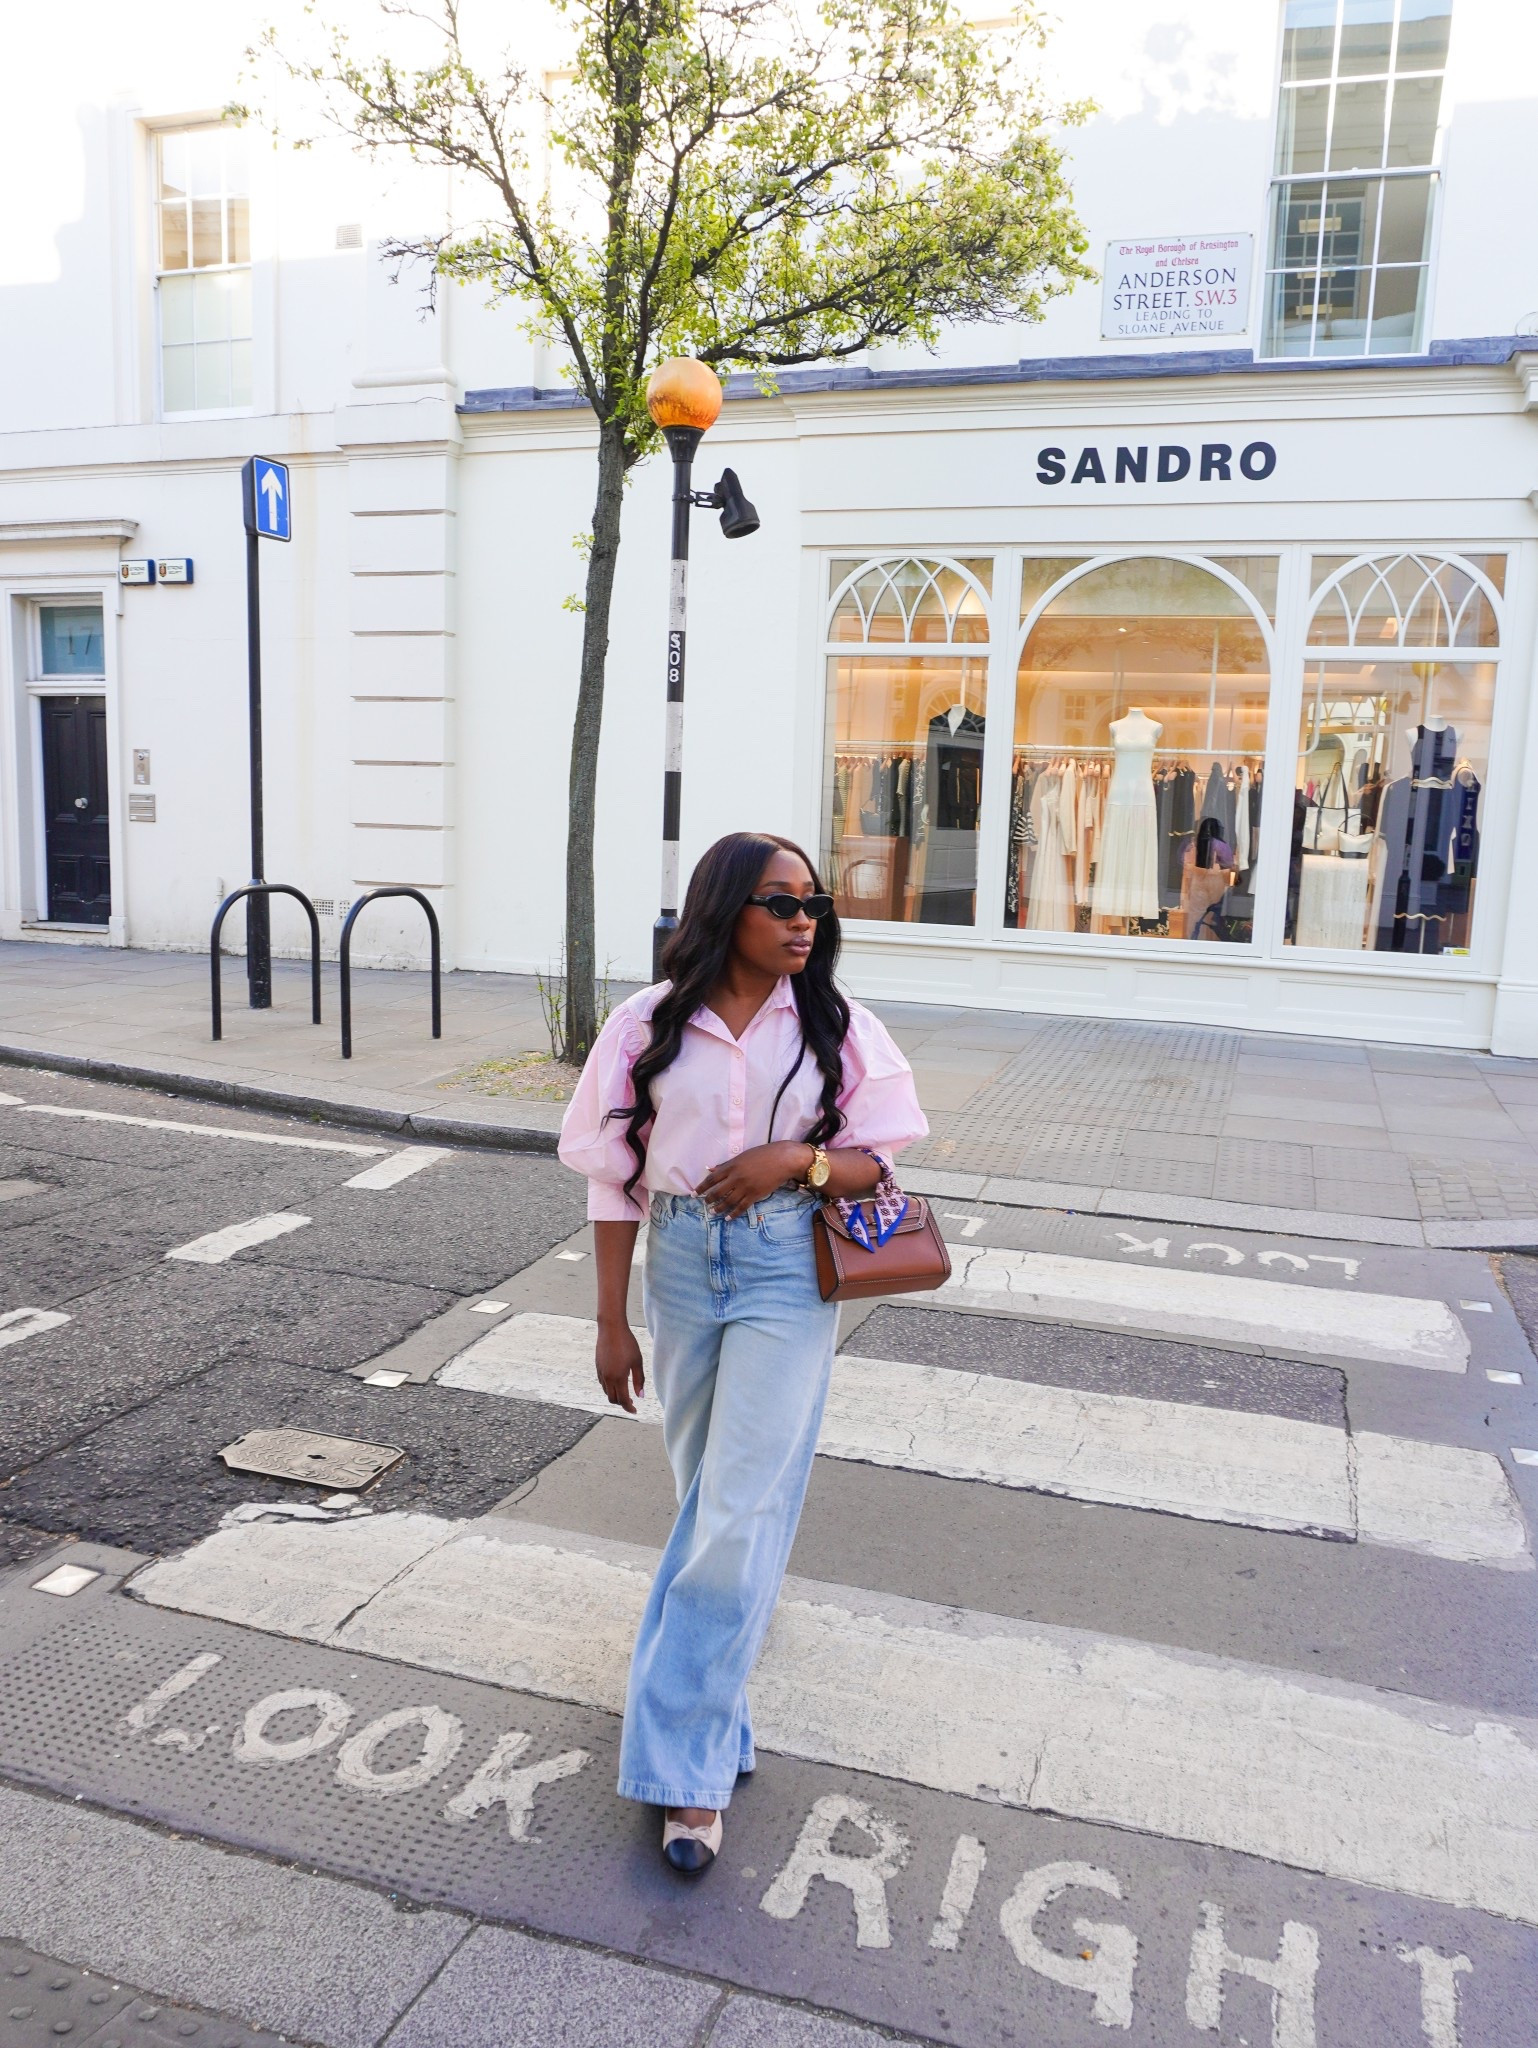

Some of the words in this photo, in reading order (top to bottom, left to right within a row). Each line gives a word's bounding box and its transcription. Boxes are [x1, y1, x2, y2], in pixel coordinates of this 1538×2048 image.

[1119, 246, 1133, 255] The
[1135, 245, 1155, 256] Royal
[1157, 244, 1186, 254] Borough
[1189, 241, 1198, 251] of
[1200, 240, 1239, 251] Kensington
[1155, 258, 1167, 267] and
[1171, 257, 1199, 267] Chelsea
[1118, 268, 1237, 290] ANDERSON
[1194, 288, 1237, 307] S.W.3
[1136, 309, 1191, 322] LEADING
[1198, 309, 1213, 319] TO
[1118, 323, 1166, 335] SLOANE
[1173, 320, 1225, 332] AVENUE
[1036, 441, 1277, 485] SANDRO
[67, 626, 94, 656] 17
[117, 1652, 592, 1844] LOOK
[759, 1795, 1474, 2048] RIGHT
